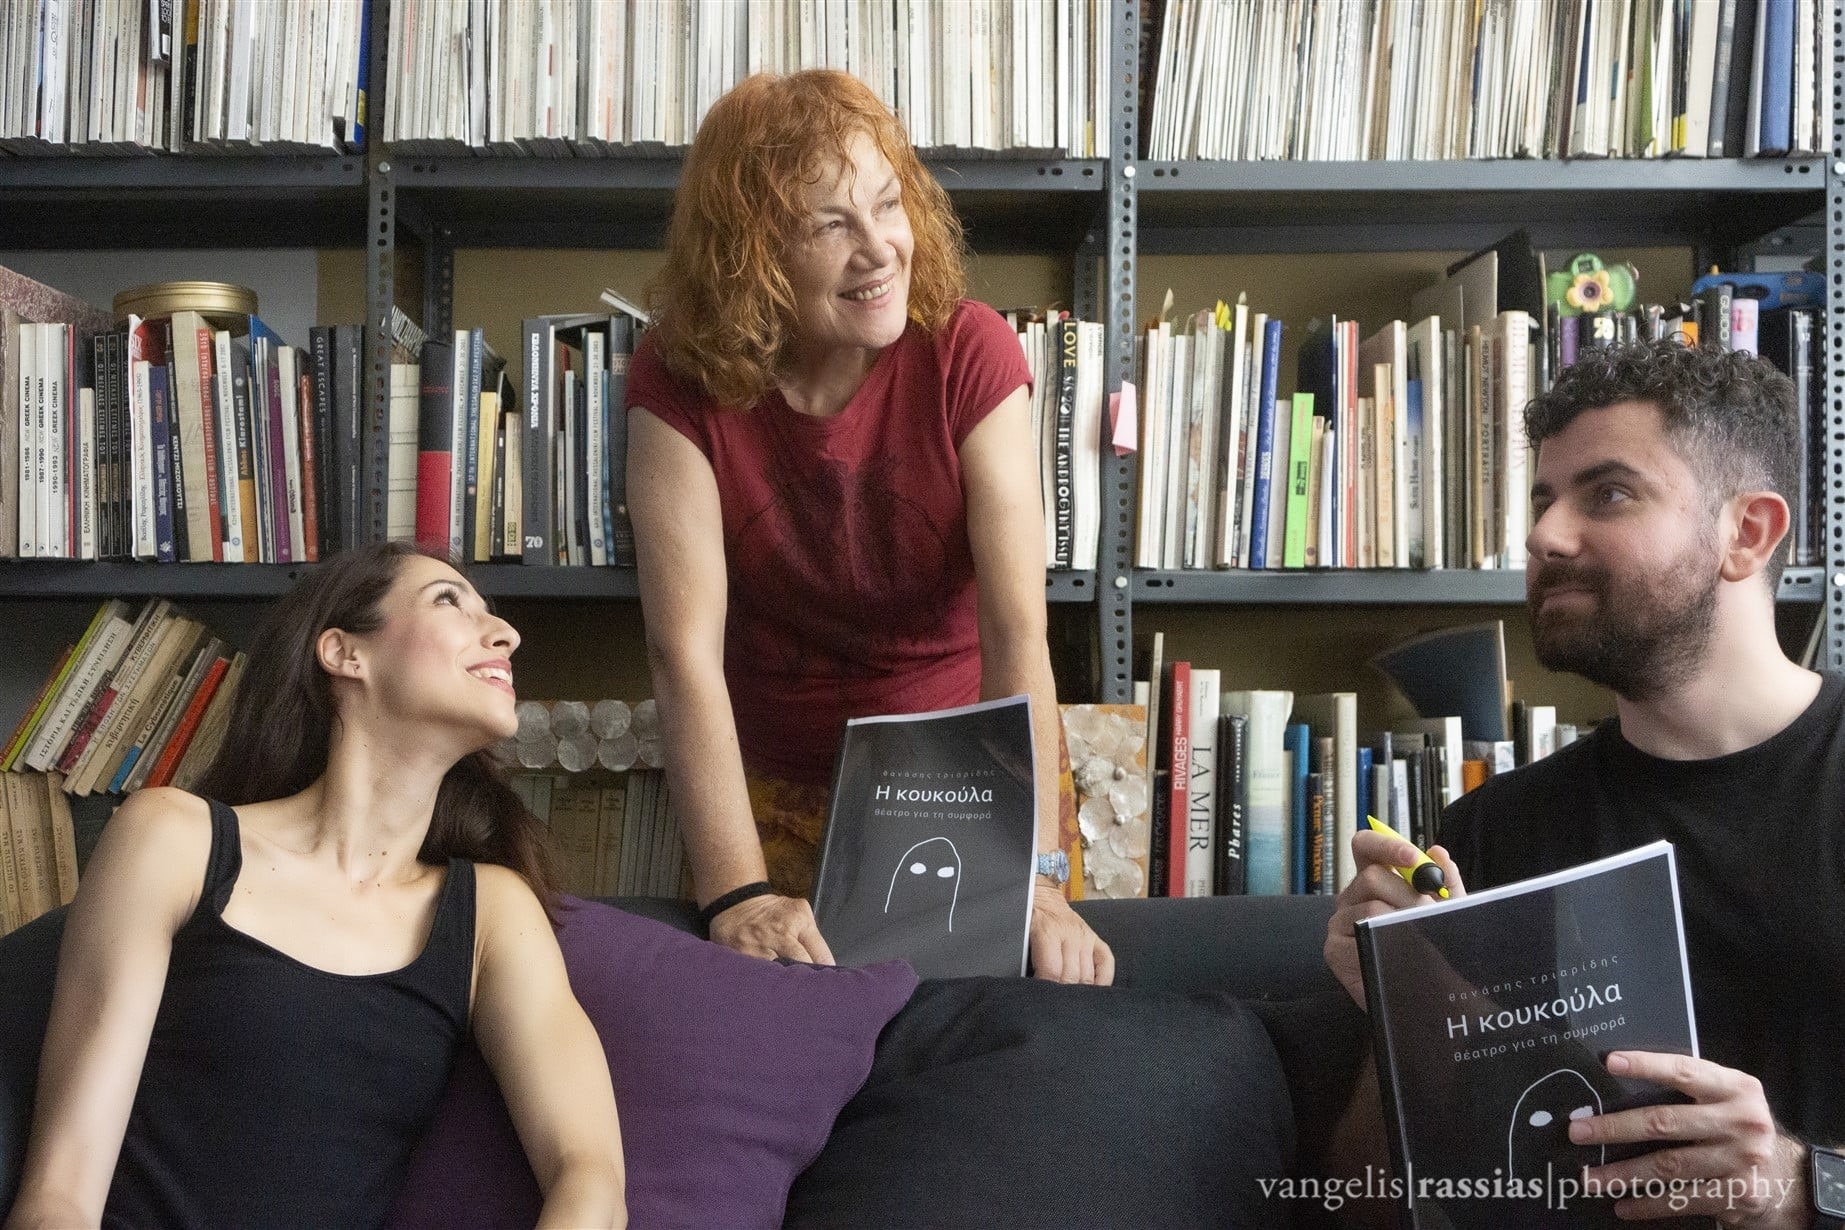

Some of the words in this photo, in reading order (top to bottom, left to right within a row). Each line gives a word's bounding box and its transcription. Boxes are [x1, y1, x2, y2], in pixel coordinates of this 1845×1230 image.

[316, 336, 325, 367] GREAT
[1063, 322, 1077, 368] LOVE
[23, 375, 31, 402] CINEMA
[317, 371, 327, 413] ESCAPES
[468, 419, 476, 465] INTERNATIONAL
[473, 330, 481, 358] FESTIVAL
[1481, 376, 1490, 414] NEWTON
[23, 403, 31, 427] GREEK
[236, 394, 247, 448] Kiarostami
[82, 441, 90, 499] ΚΙΝΗΜΑΤΟΓΡΑΦΙΑ
[240, 449, 249, 476] Abbas
[1482, 422, 1490, 484] PORTRAITS
[83, 501, 91, 534] ΕΛΛΗΝΙΚΗ
[525, 536, 543, 548] 70
[1054, 536, 1070, 568] ISSUE
[39, 725, 62, 758] ΙΣΤΟΡΙΑ
[60, 709, 72, 726] ΚΑΙ
[87, 632, 117, 678] ΣΥΝΕΙΔΗΣΗ
[1175, 680, 1184, 713] GRUYAERT
[1175, 713, 1183, 736] HARRY
[1173, 736, 1188, 791] RIVAGES
[1191, 745, 1213, 780] LA
[874, 808, 910, 818] θέατρο
[913, 810, 929, 819] για
[932, 811, 944, 819] τη
[947, 809, 992, 820] συμφορά
[875, 785, 891, 801] Η
[896, 785, 993, 803] κουκούλα
[1189, 791, 1212, 853] MER
[1228, 802, 1241, 860] Phares
[1313, 833, 1325, 883] Windows
[1448, 978, 1523, 1002] θανάσης
[1530, 954, 1619, 986] τριαρίδης
[1446, 1014, 1469, 1039] Η
[1479, 982, 1623, 1033] κουκούλα
[1454, 1044, 1507, 1062] θέατρο
[1511, 1037, 1536, 1052] για
[1540, 1033, 1558, 1046] τη
[1563, 1013, 1626, 1041] συμφορά
